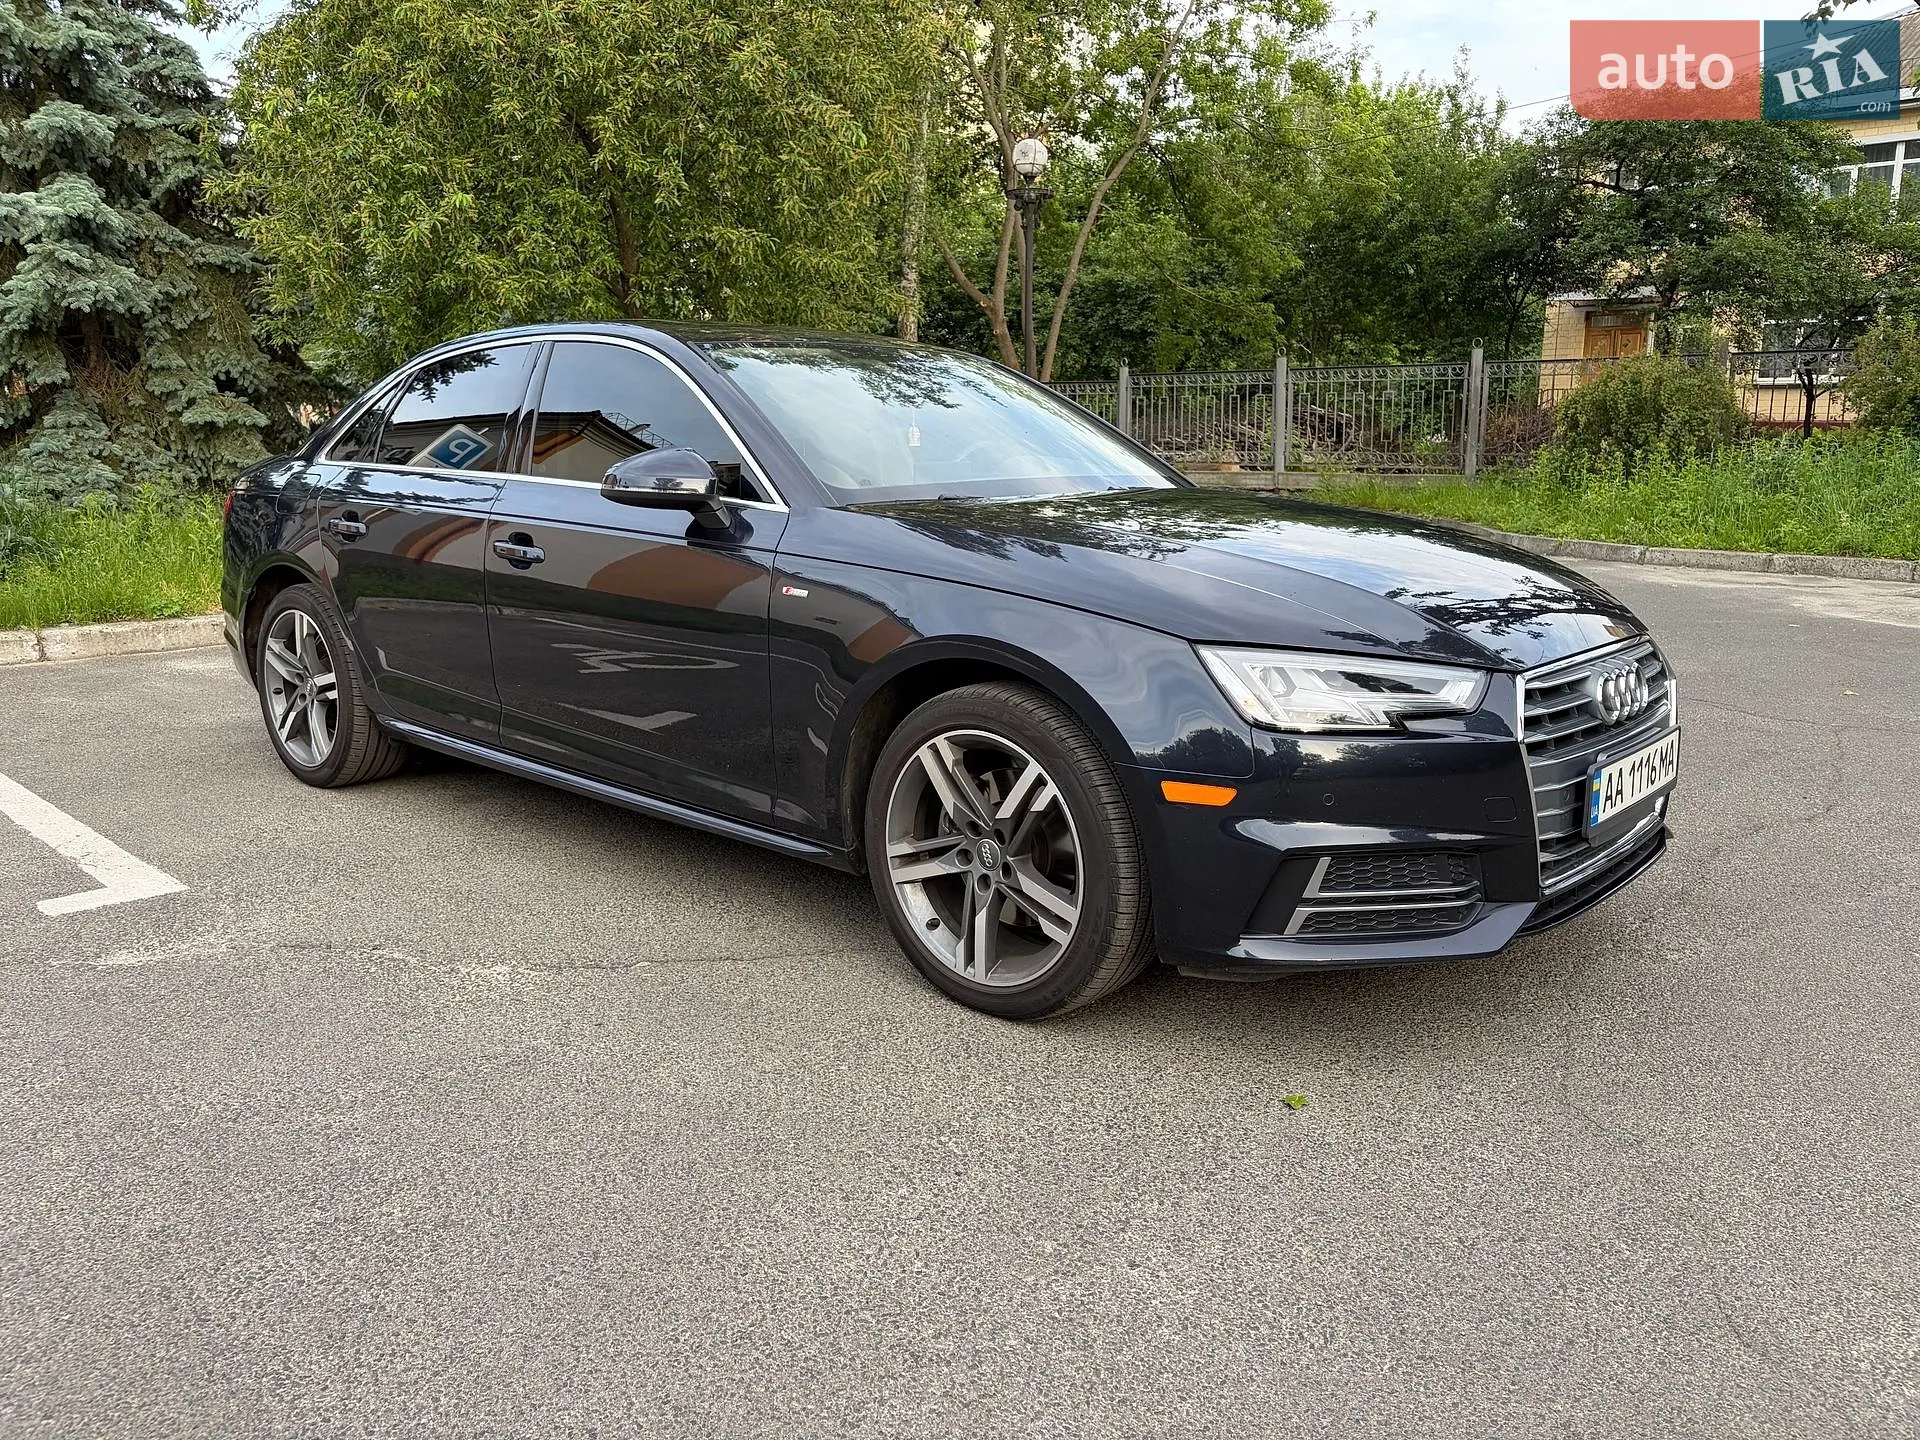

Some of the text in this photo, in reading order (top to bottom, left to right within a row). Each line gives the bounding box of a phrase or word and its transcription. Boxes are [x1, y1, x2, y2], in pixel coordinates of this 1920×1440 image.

[1602, 739, 1675, 814] AA 1116 MA
